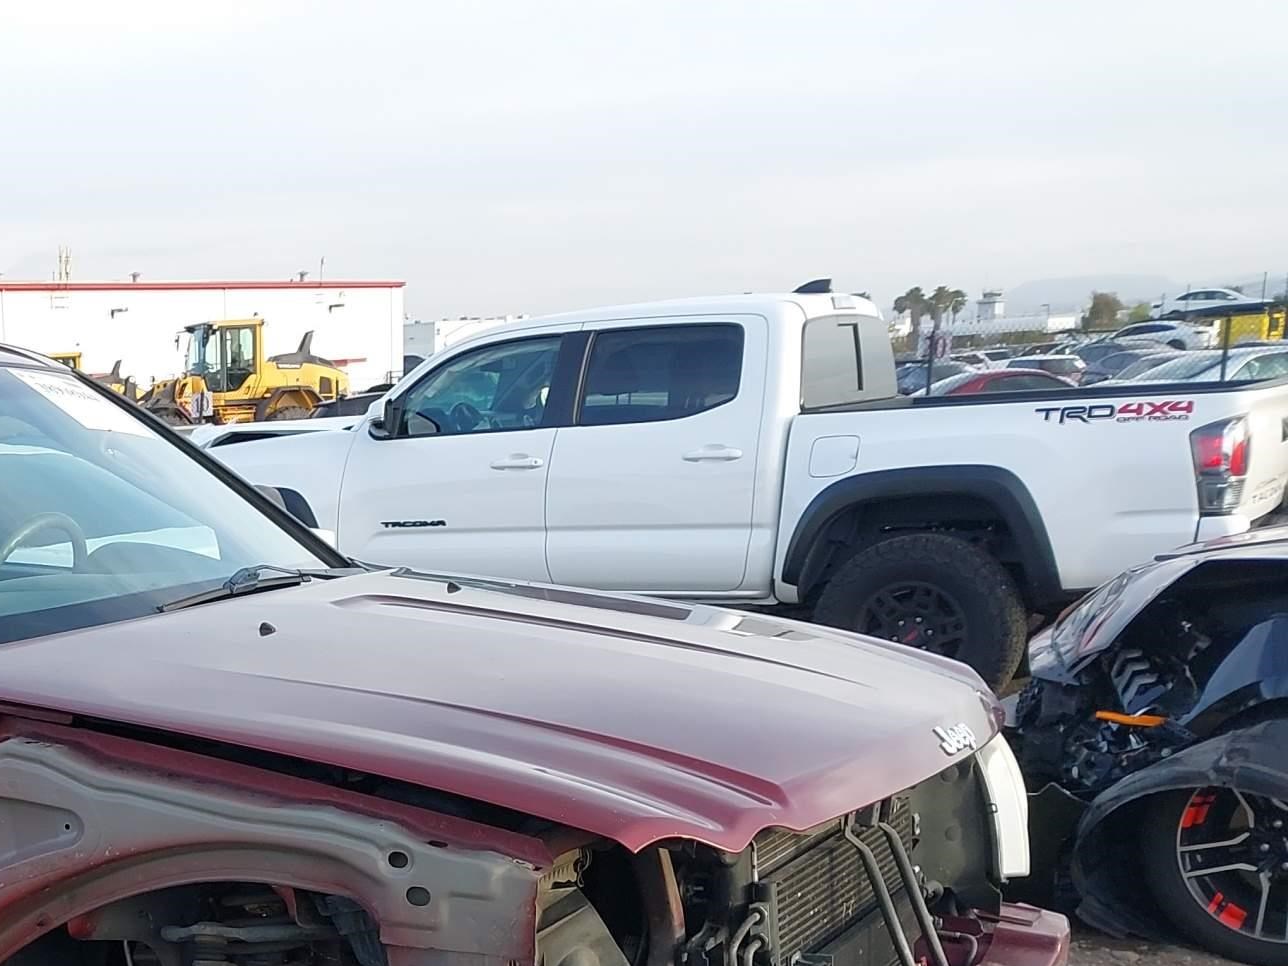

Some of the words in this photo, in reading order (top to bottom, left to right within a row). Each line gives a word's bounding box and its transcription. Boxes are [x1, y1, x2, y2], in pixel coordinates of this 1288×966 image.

[1035, 404, 1115, 424] TRD
[1116, 415, 1144, 423] OFF
[1148, 414, 1189, 422] ROAD
[380, 519, 447, 529] TACOMA
[932, 723, 977, 756] Jeep
